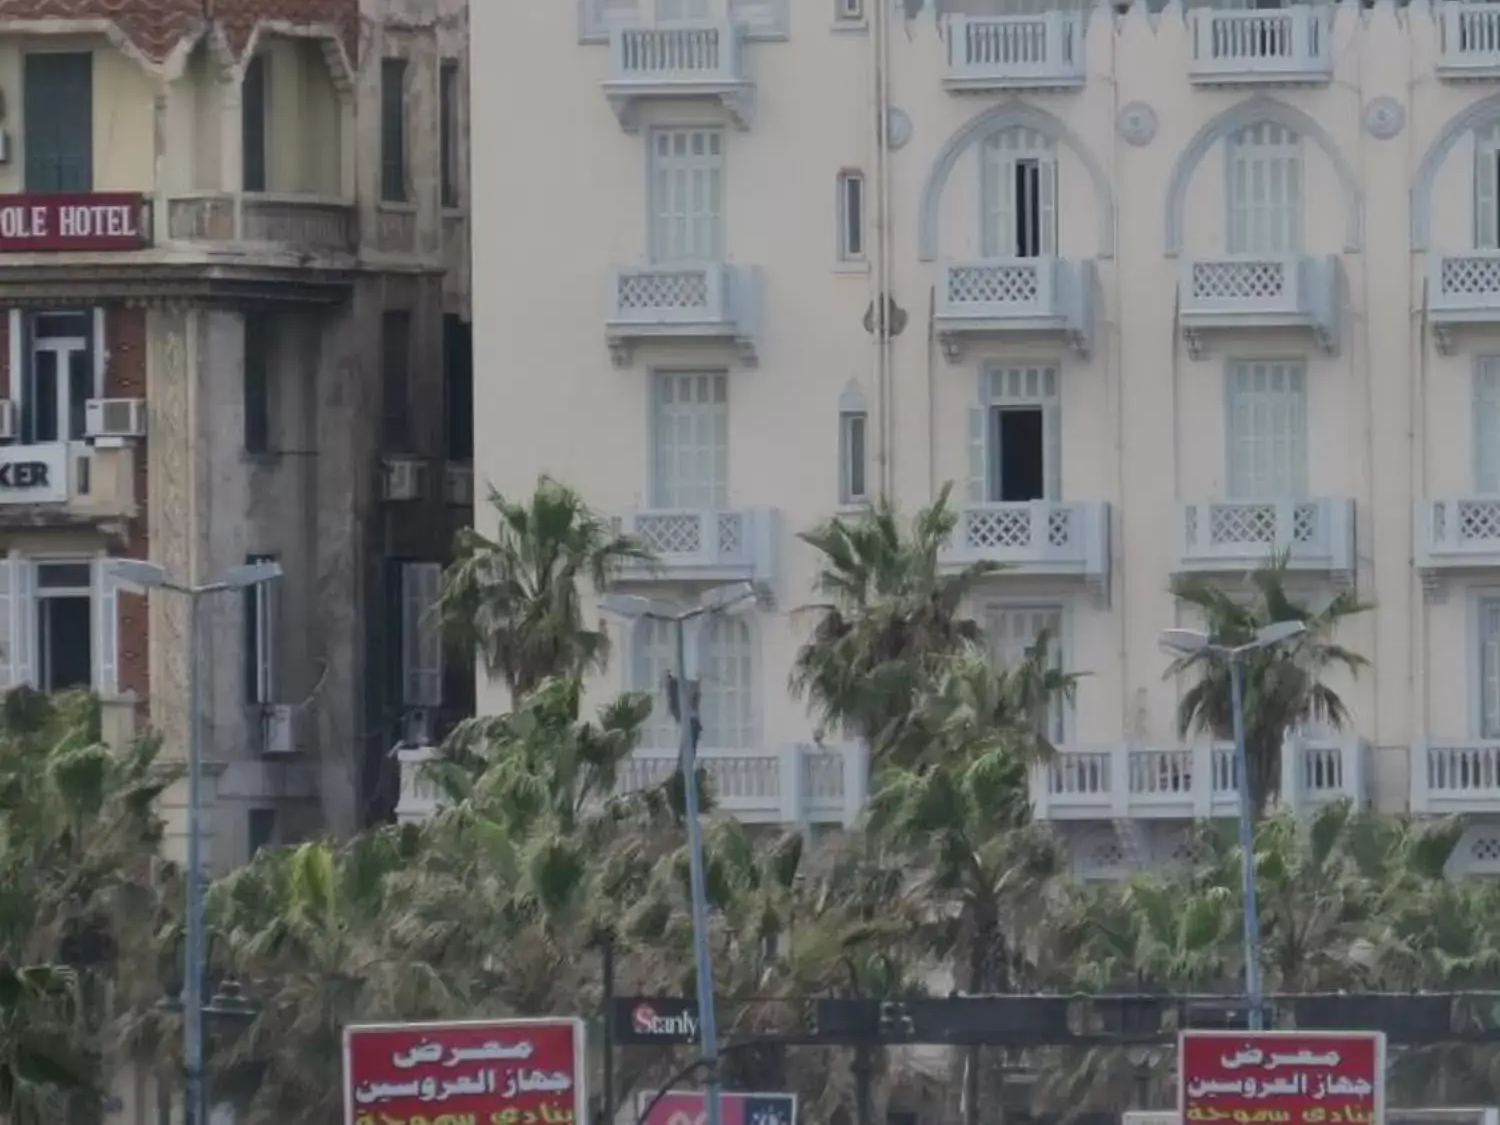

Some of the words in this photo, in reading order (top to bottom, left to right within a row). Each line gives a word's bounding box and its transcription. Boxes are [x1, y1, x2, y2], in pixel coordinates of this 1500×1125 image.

[0, 206, 48, 237] OLE
[58, 206, 136, 236] HOTEL
[393, 1037, 534, 1068] معرض
[1221, 1043, 1341, 1069] معرض
[356, 1068, 496, 1103] العروسين
[502, 1068, 572, 1098] جهاز
[1187, 1074, 1307, 1097] العروسين
[1312, 1073, 1372, 1100] جهاز
